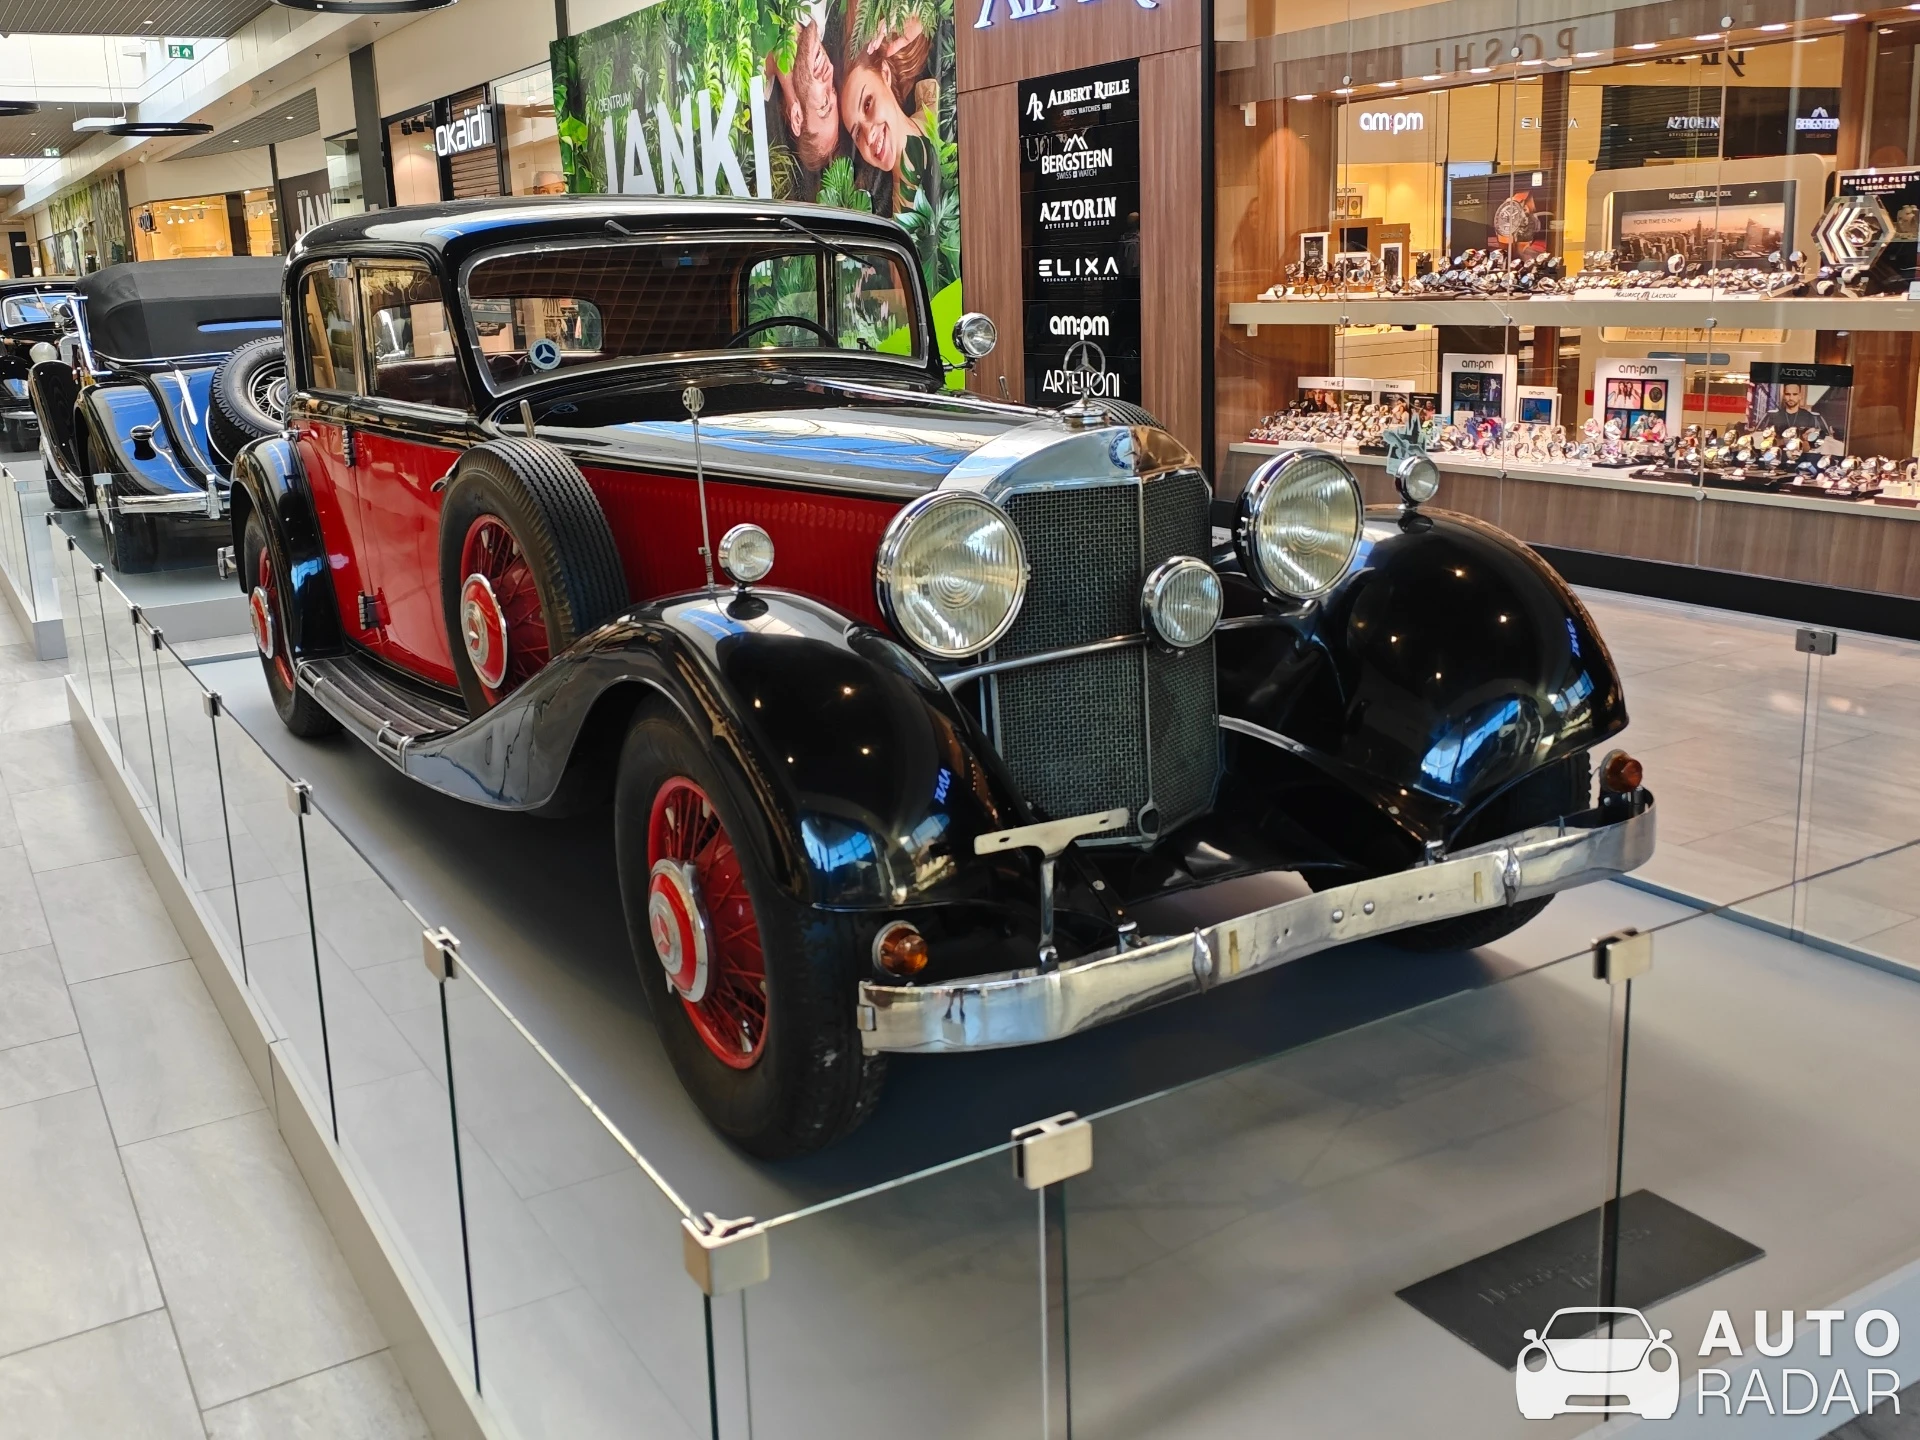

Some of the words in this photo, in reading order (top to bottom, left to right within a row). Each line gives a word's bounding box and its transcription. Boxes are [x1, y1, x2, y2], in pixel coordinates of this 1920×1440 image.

[598, 91, 633, 112] CENTRUM
[1047, 88, 1092, 109] ALBERT
[1094, 79, 1130, 100] RIELE
[1062, 108, 1077, 116] SWISS
[1078, 104, 1100, 114] WATCHES
[435, 104, 487, 157] okaïdi
[1359, 112, 1424, 135] am:pm
[1521, 117, 1579, 129] ELA
[1041, 147, 1113, 175] BERGSTERN
[1056, 172, 1072, 181] SWISS
[1077, 168, 1097, 178] WATCH
[1843, 177, 1884, 185] PHILIPP
[1040, 196, 1117, 222] AZTORIN
[1044, 221, 1079, 230] ATTITUDE
[1084, 219, 1110, 227] INSIDE
[1038, 257, 1119, 277] ELIXA
[1049, 315, 1110, 341] am:pm
[1462, 360, 1494, 370] am:pm
[1618, 364, 1657, 376] am:pm
